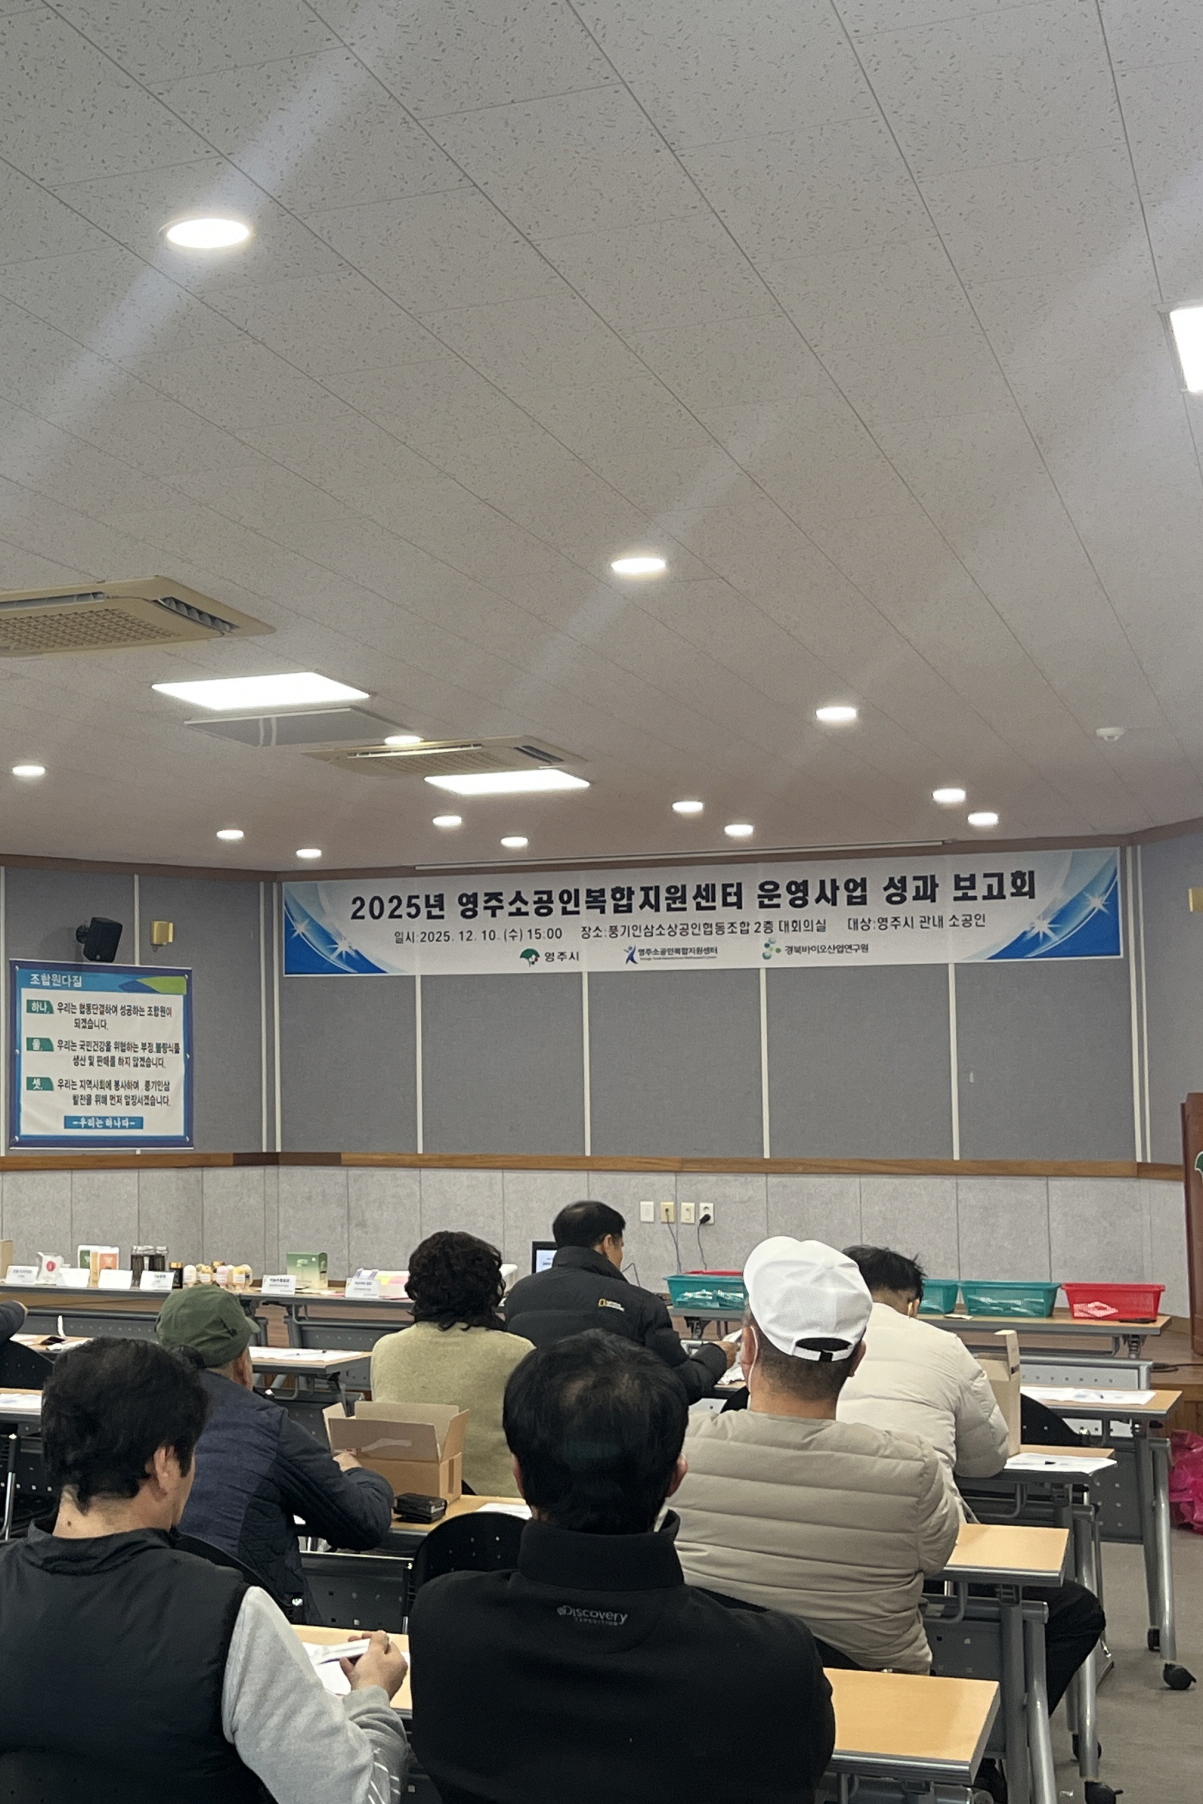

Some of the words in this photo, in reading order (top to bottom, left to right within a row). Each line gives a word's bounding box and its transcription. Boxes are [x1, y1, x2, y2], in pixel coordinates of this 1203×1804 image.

[351, 891, 446, 920] 2025년
[457, 881, 744, 918] 영주소공인복합지원센터
[757, 876, 868, 909] 운영사업
[883, 873, 939, 905] 성과
[953, 870, 1036, 903] 보고회
[459, 929, 477, 942] 12.
[481, 929, 501, 941] 10.
[503, 927, 523, 942] (수)
[527, 926, 563, 940] 15:00
[754, 920, 774, 935] 2층
[778, 918, 827, 934] 대회의실
[919, 914, 944, 930] 관내
[948, 912, 986, 928] 소공인
[784, 943, 868, 955] 경북바이오산업연구원
[544, 950, 580, 964] 영주시
[30, 973, 83, 988] 조합원다짐
[57, 1002, 77, 1014] 우리는
[79, 1003, 118, 1016] 협동단결하여
[119, 1004, 145, 1017] 성공하는
[147, 1005, 172, 1018] 조합원이
[74, 1018, 109, 1031] 되겠습니다.
[57, 1039, 77, 1051] 우리는
[79, 1040, 111, 1053] 국민건강을
[113, 1041, 139, 1053] 위협하는
[73, 1055, 86, 1067] 생산
[88, 1056, 95, 1067] 및
[97, 1056, 116, 1067] 판매를
[118, 1056, 130, 1068] 하지
[57, 1078, 77, 1091] 우리는
[79, 1079, 112, 1091] 지역사회에
[144, 1080, 170, 1092] 풍기인삼
[94, 1095, 108, 1106] 위해
[109, 1095, 122, 1106] 먼저
